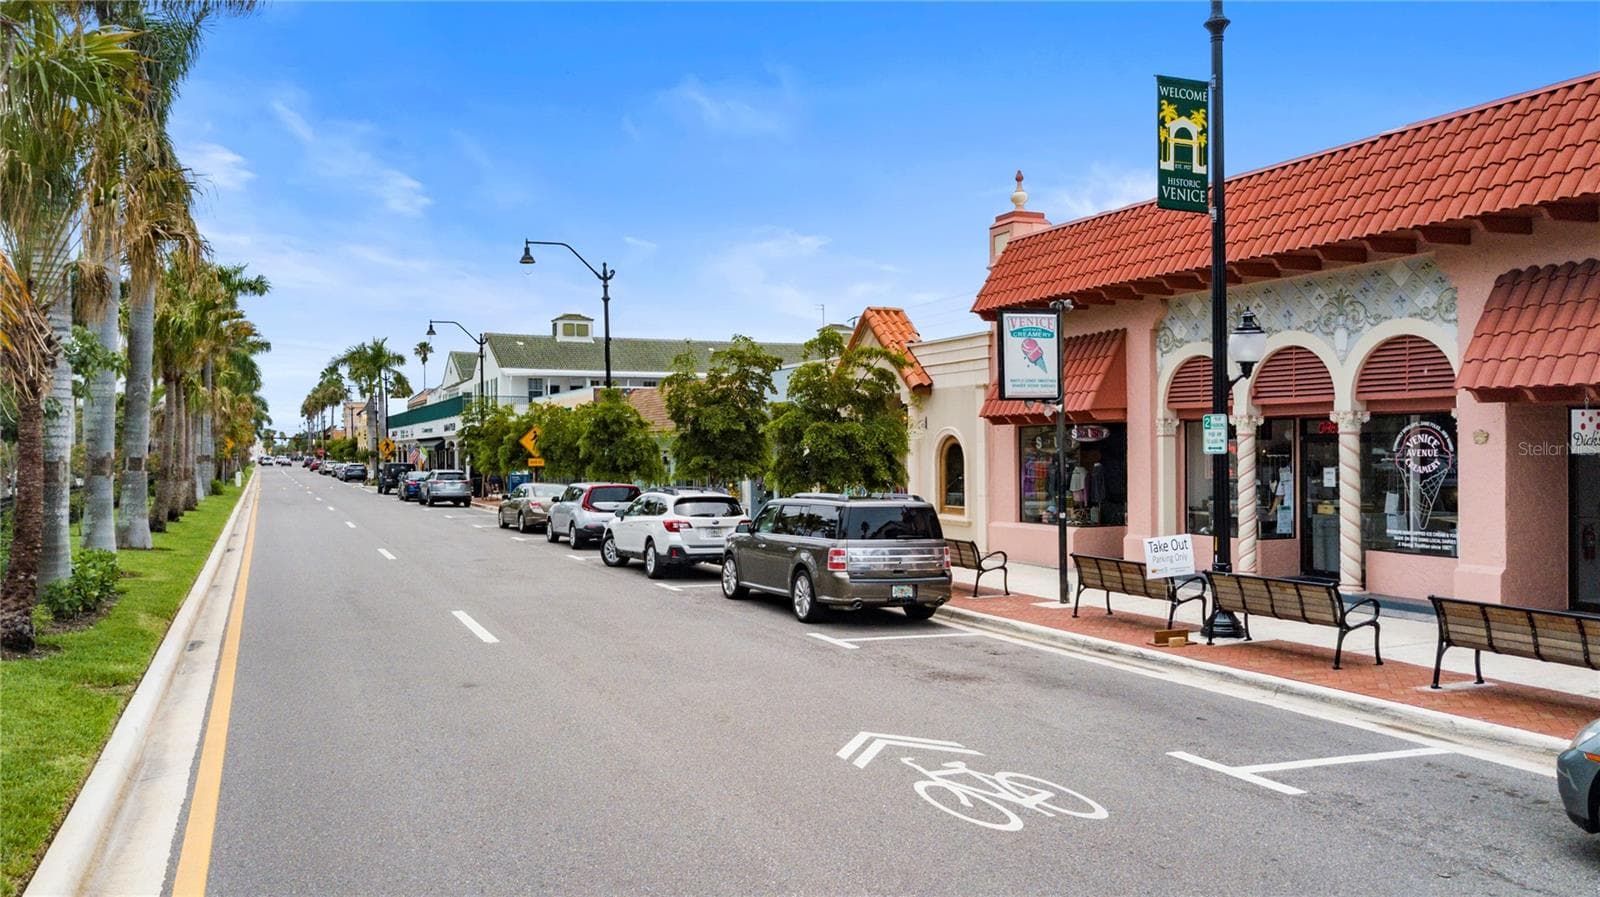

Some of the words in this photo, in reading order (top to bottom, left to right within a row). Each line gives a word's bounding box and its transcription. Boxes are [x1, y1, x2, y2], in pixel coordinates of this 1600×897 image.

[1160, 85, 1207, 101] WELCOME
[1167, 177, 1201, 188] HISTORIC
[1162, 185, 1206, 203] VENICE
[1007, 316, 1057, 331] VENICE
[1204, 417, 1211, 428] 2
[1406, 434, 1441, 448] VENICE
[1406, 449, 1439, 457] AVENUE
[1405, 458, 1441, 474] CREAMERY
[1148, 540, 1169, 553] Take
[1171, 539, 1189, 551] Out
[1152, 555, 1174, 564] Parking
[1175, 552, 1188, 562] Only
